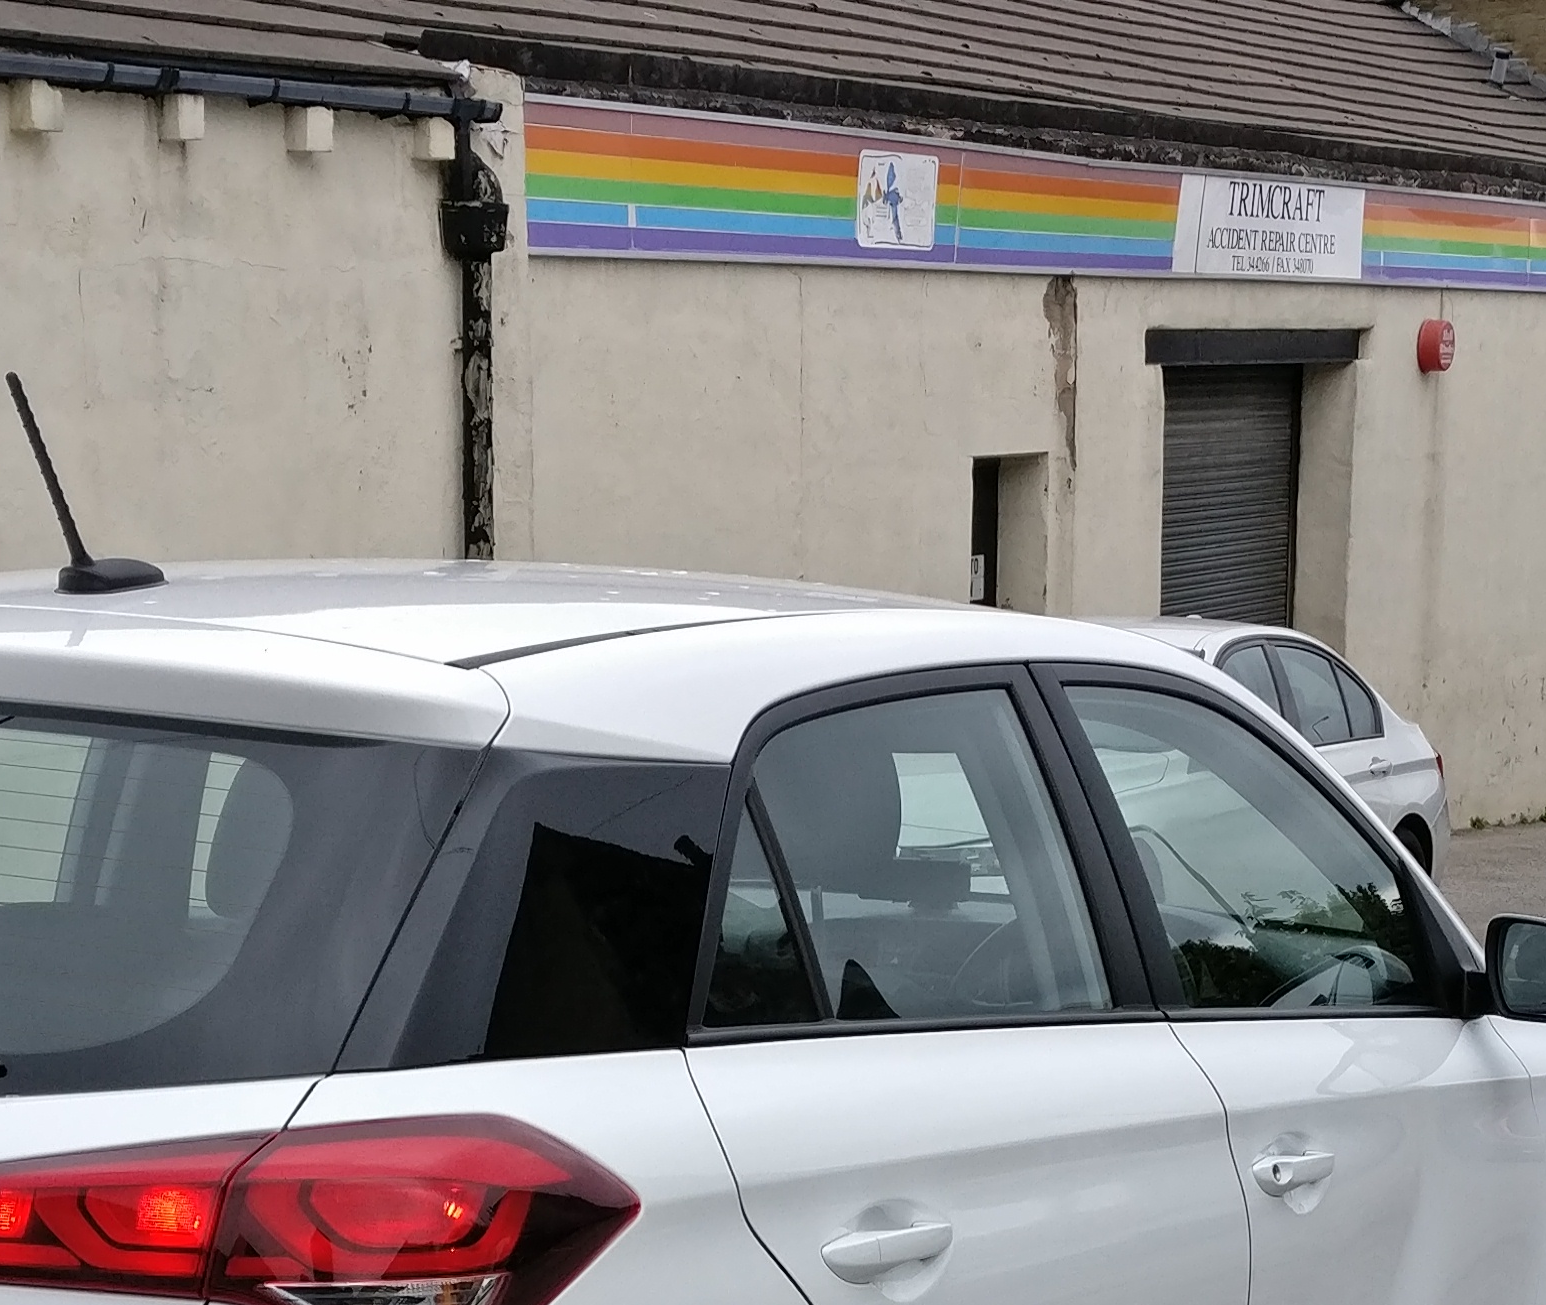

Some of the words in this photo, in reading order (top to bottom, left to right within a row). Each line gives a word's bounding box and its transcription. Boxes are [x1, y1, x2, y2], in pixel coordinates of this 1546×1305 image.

[1228, 181, 1325, 222] TRIMCRAFT
[1207, 227, 1259, 251] ACCIDENT
[1260, 230, 1296, 253] REPAIR
[1298, 232, 1336, 255] CENTRE
[1232, 255, 1245, 272] TEL
[1276, 257, 1291, 273] FAX
